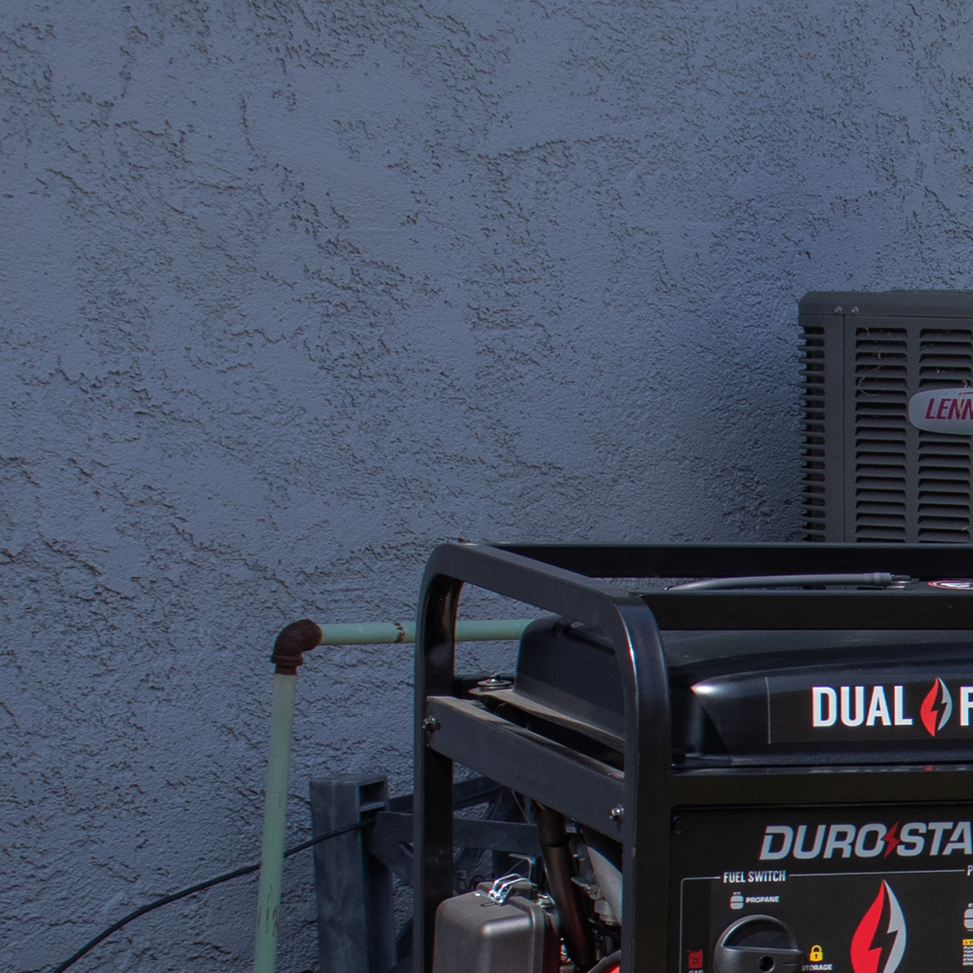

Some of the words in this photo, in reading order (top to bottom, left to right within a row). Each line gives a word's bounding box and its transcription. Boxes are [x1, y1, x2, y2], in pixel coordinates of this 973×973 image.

[811, 684, 914, 728] DUAL
[722, 871, 746, 884] FUEL
[747, 870, 787, 883] SWITCH
[745, 895, 780, 904] PROPANE
[801, 963, 834, 972] STORAGE
